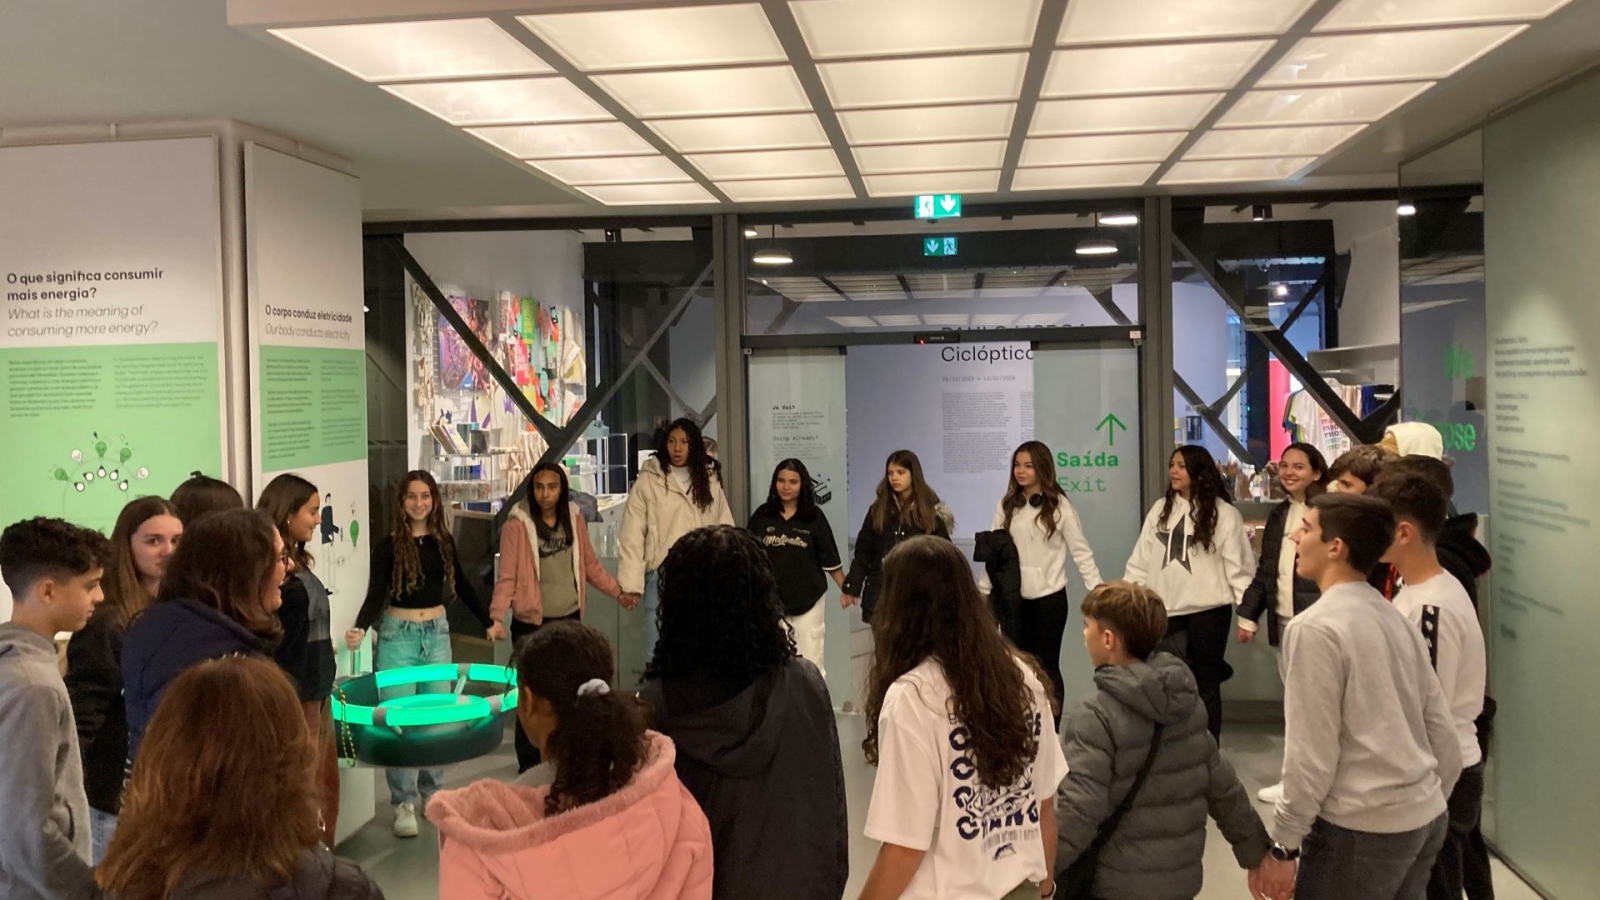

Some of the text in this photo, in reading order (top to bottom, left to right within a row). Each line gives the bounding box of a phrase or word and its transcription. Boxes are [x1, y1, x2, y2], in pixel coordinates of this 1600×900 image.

[7, 267, 164, 286] O que significa consumir
[7, 287, 97, 301] mais energia?
[8, 304, 144, 320] What is the meaning of
[265, 304, 353, 323] O corpo conduz eletricidade
[7, 320, 159, 338] consuming more energy?
[265, 323, 278, 335] Our
[279, 324, 295, 338] body
[296, 327, 324, 338] conducts
[1057, 450, 1119, 467] Saída
[1058, 476, 1107, 492] Exit
